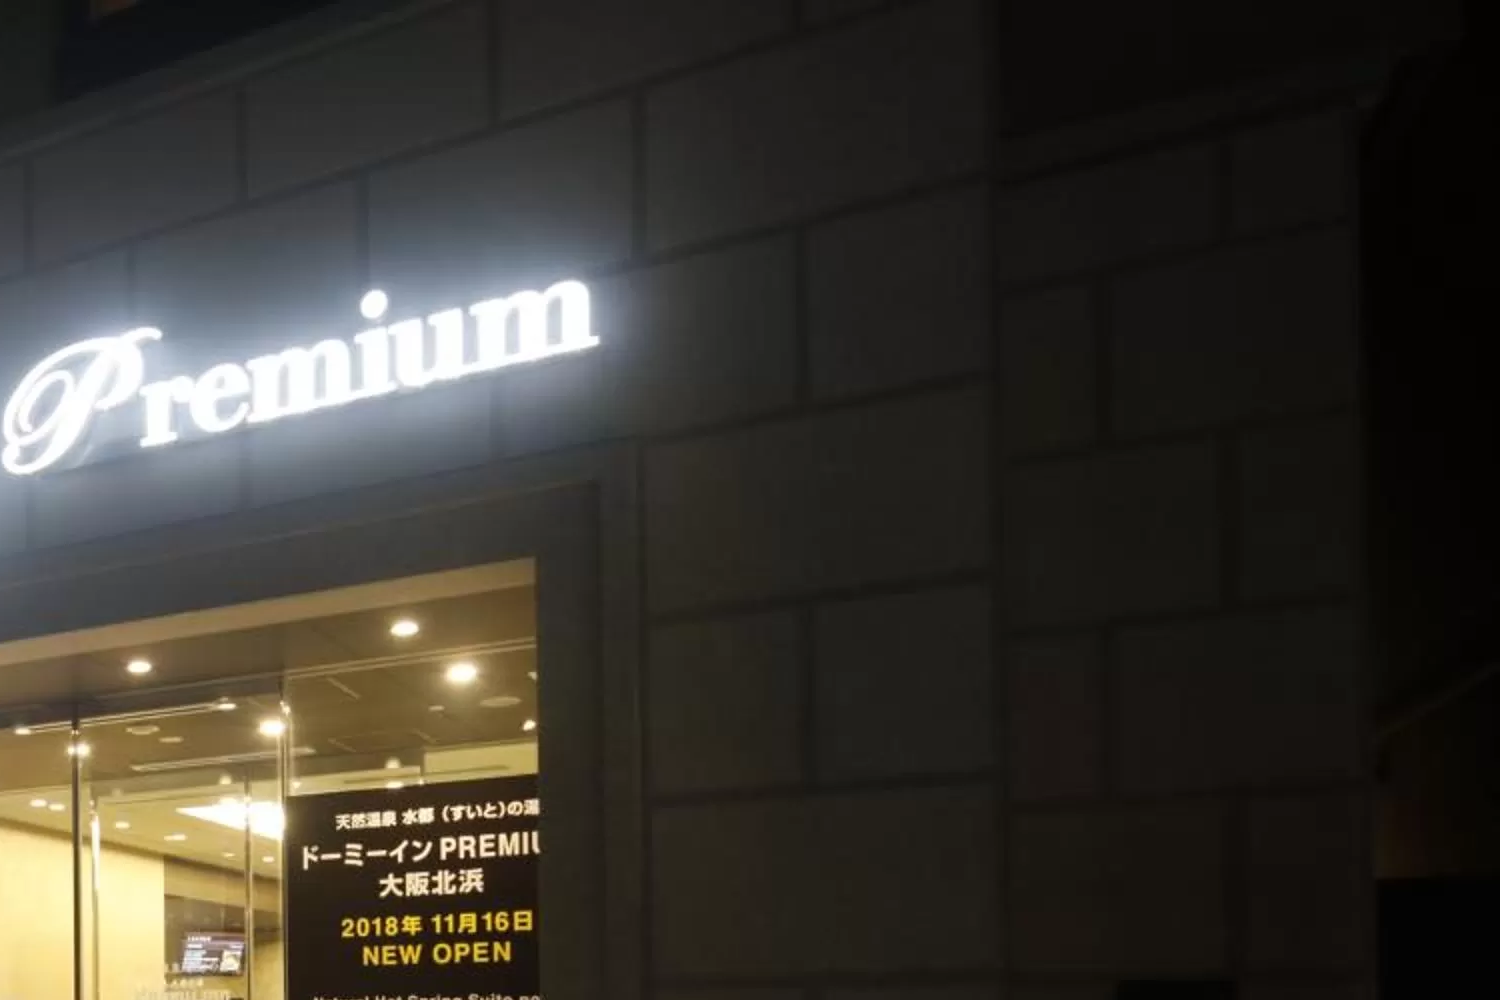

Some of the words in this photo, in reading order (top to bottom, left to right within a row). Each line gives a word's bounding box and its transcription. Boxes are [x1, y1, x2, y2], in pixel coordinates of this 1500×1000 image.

[2, 278, 599, 475] Premium
[336, 811, 396, 831] 天然温泉
[303, 840, 432, 870] ドーミーイン
[379, 868, 484, 898] 大阪北浜
[362, 945, 421, 966] NEW
[433, 941, 512, 964] OPEN
